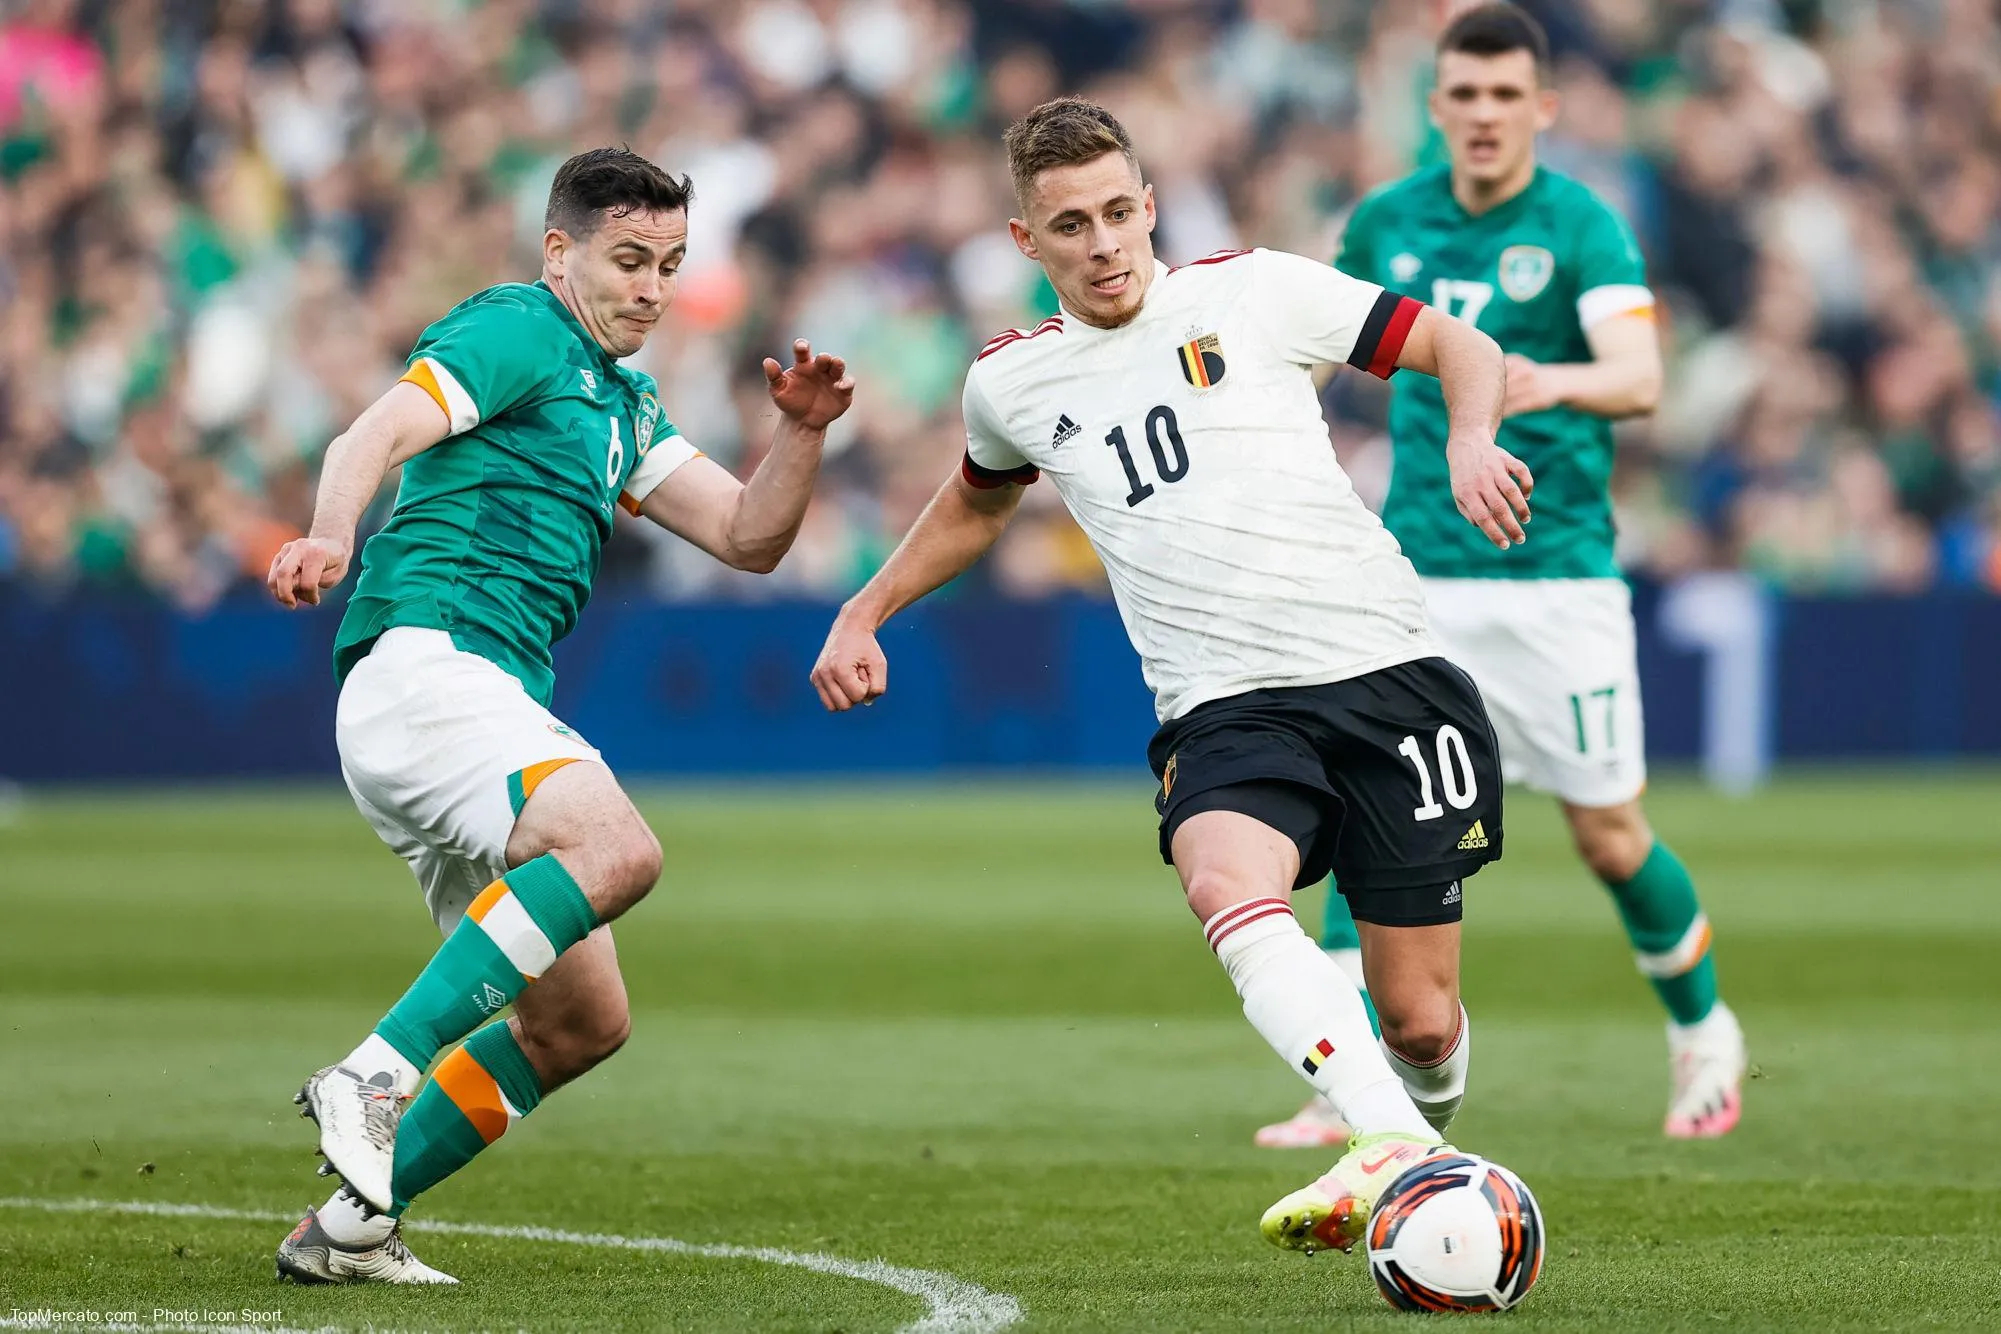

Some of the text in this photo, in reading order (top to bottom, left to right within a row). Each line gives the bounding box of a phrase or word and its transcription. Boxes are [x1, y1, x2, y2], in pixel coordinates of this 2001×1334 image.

[606, 416, 624, 489] 6
[1052, 424, 1082, 450] adidas
[1104, 405, 1190, 507] 10
[1568, 687, 1616, 753] 17
[1398, 724, 1478, 822] 10
[1457, 837, 1489, 850] adidas
